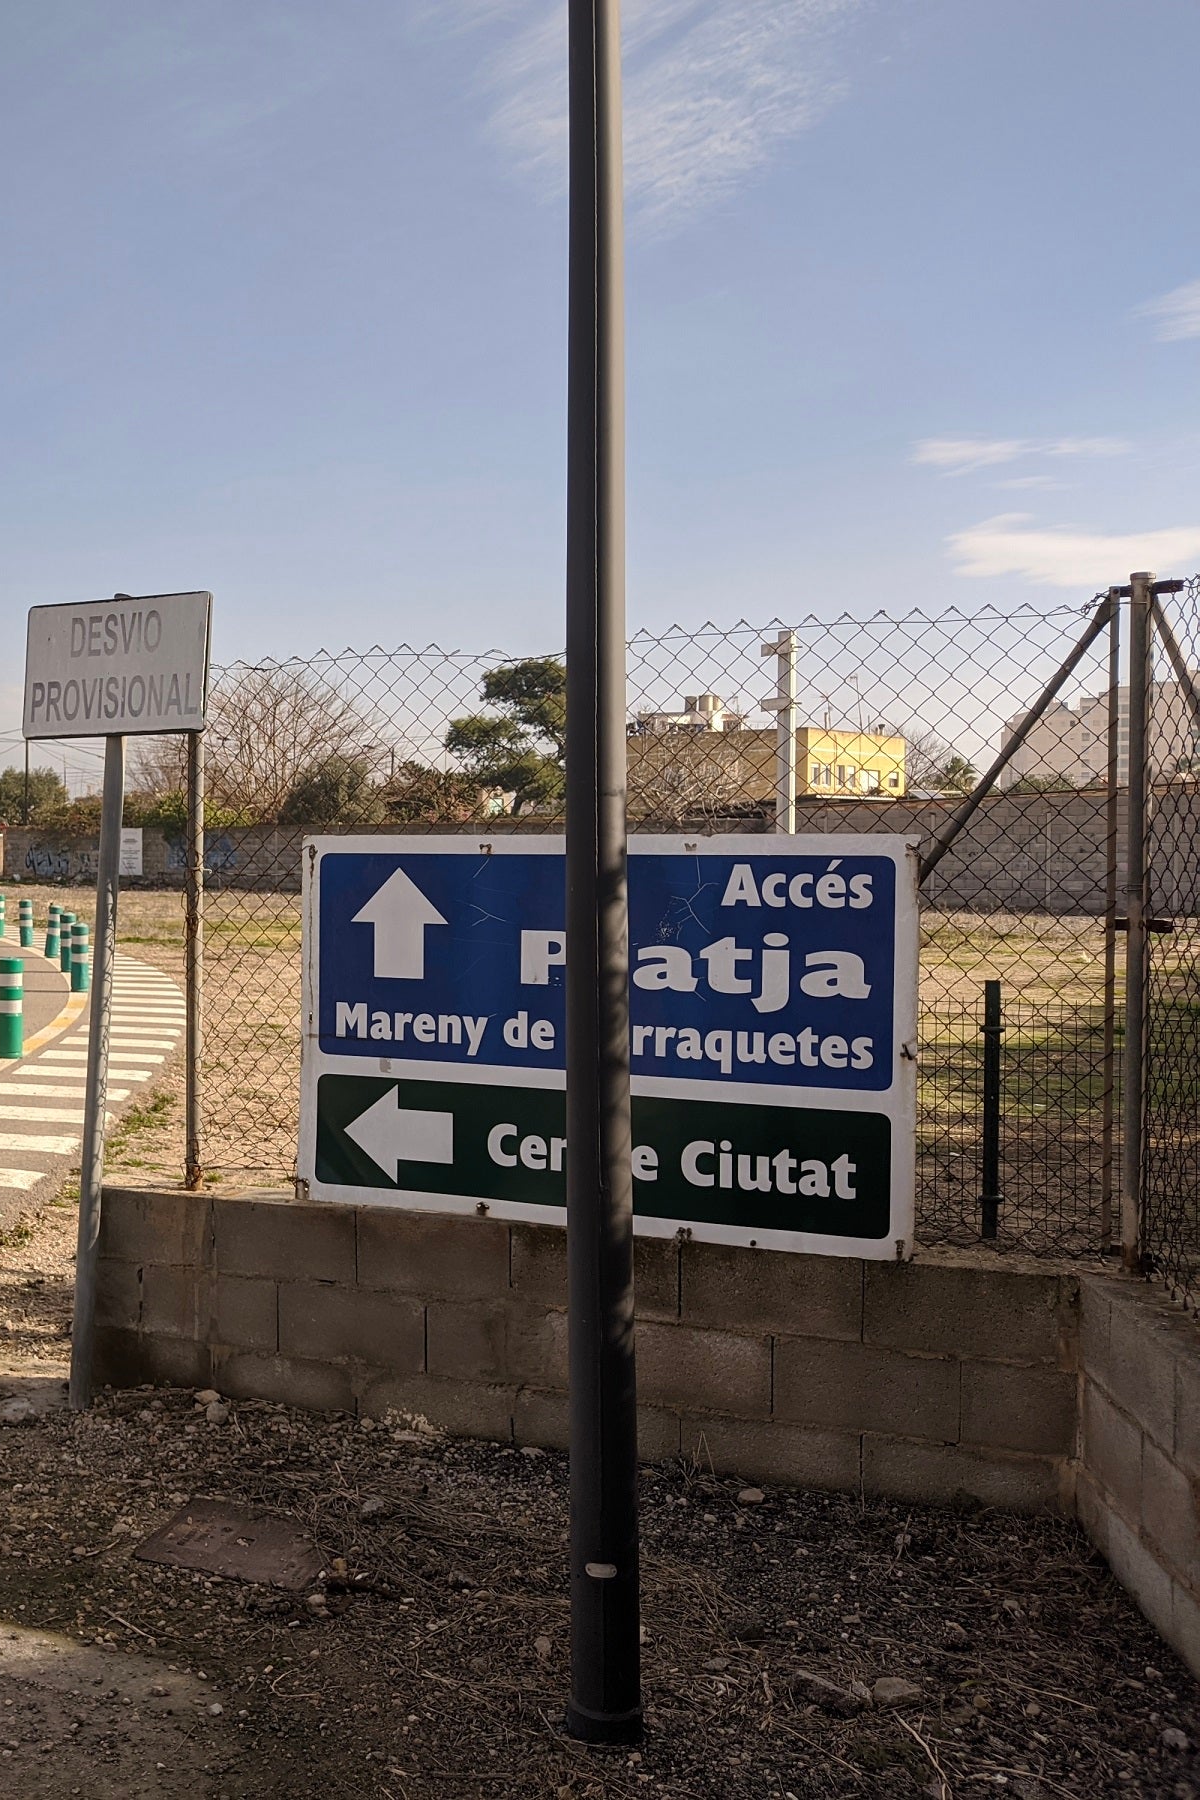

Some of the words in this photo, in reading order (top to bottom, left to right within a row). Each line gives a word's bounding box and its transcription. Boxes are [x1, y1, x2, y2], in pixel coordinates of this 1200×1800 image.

[70, 609, 163, 658] DESVIO
[30, 673, 199, 723] PROVISIONAL
[720, 859, 874, 909] Accés
[520, 920, 872, 1013] Patja
[335, 1001, 489, 1056] Mareny
[503, 1010, 556, 1050] de
[632, 1025, 874, 1074] rraquetes
[487, 1123, 659, 1182] Cene
[680, 1140, 857, 1200] Ciutat
